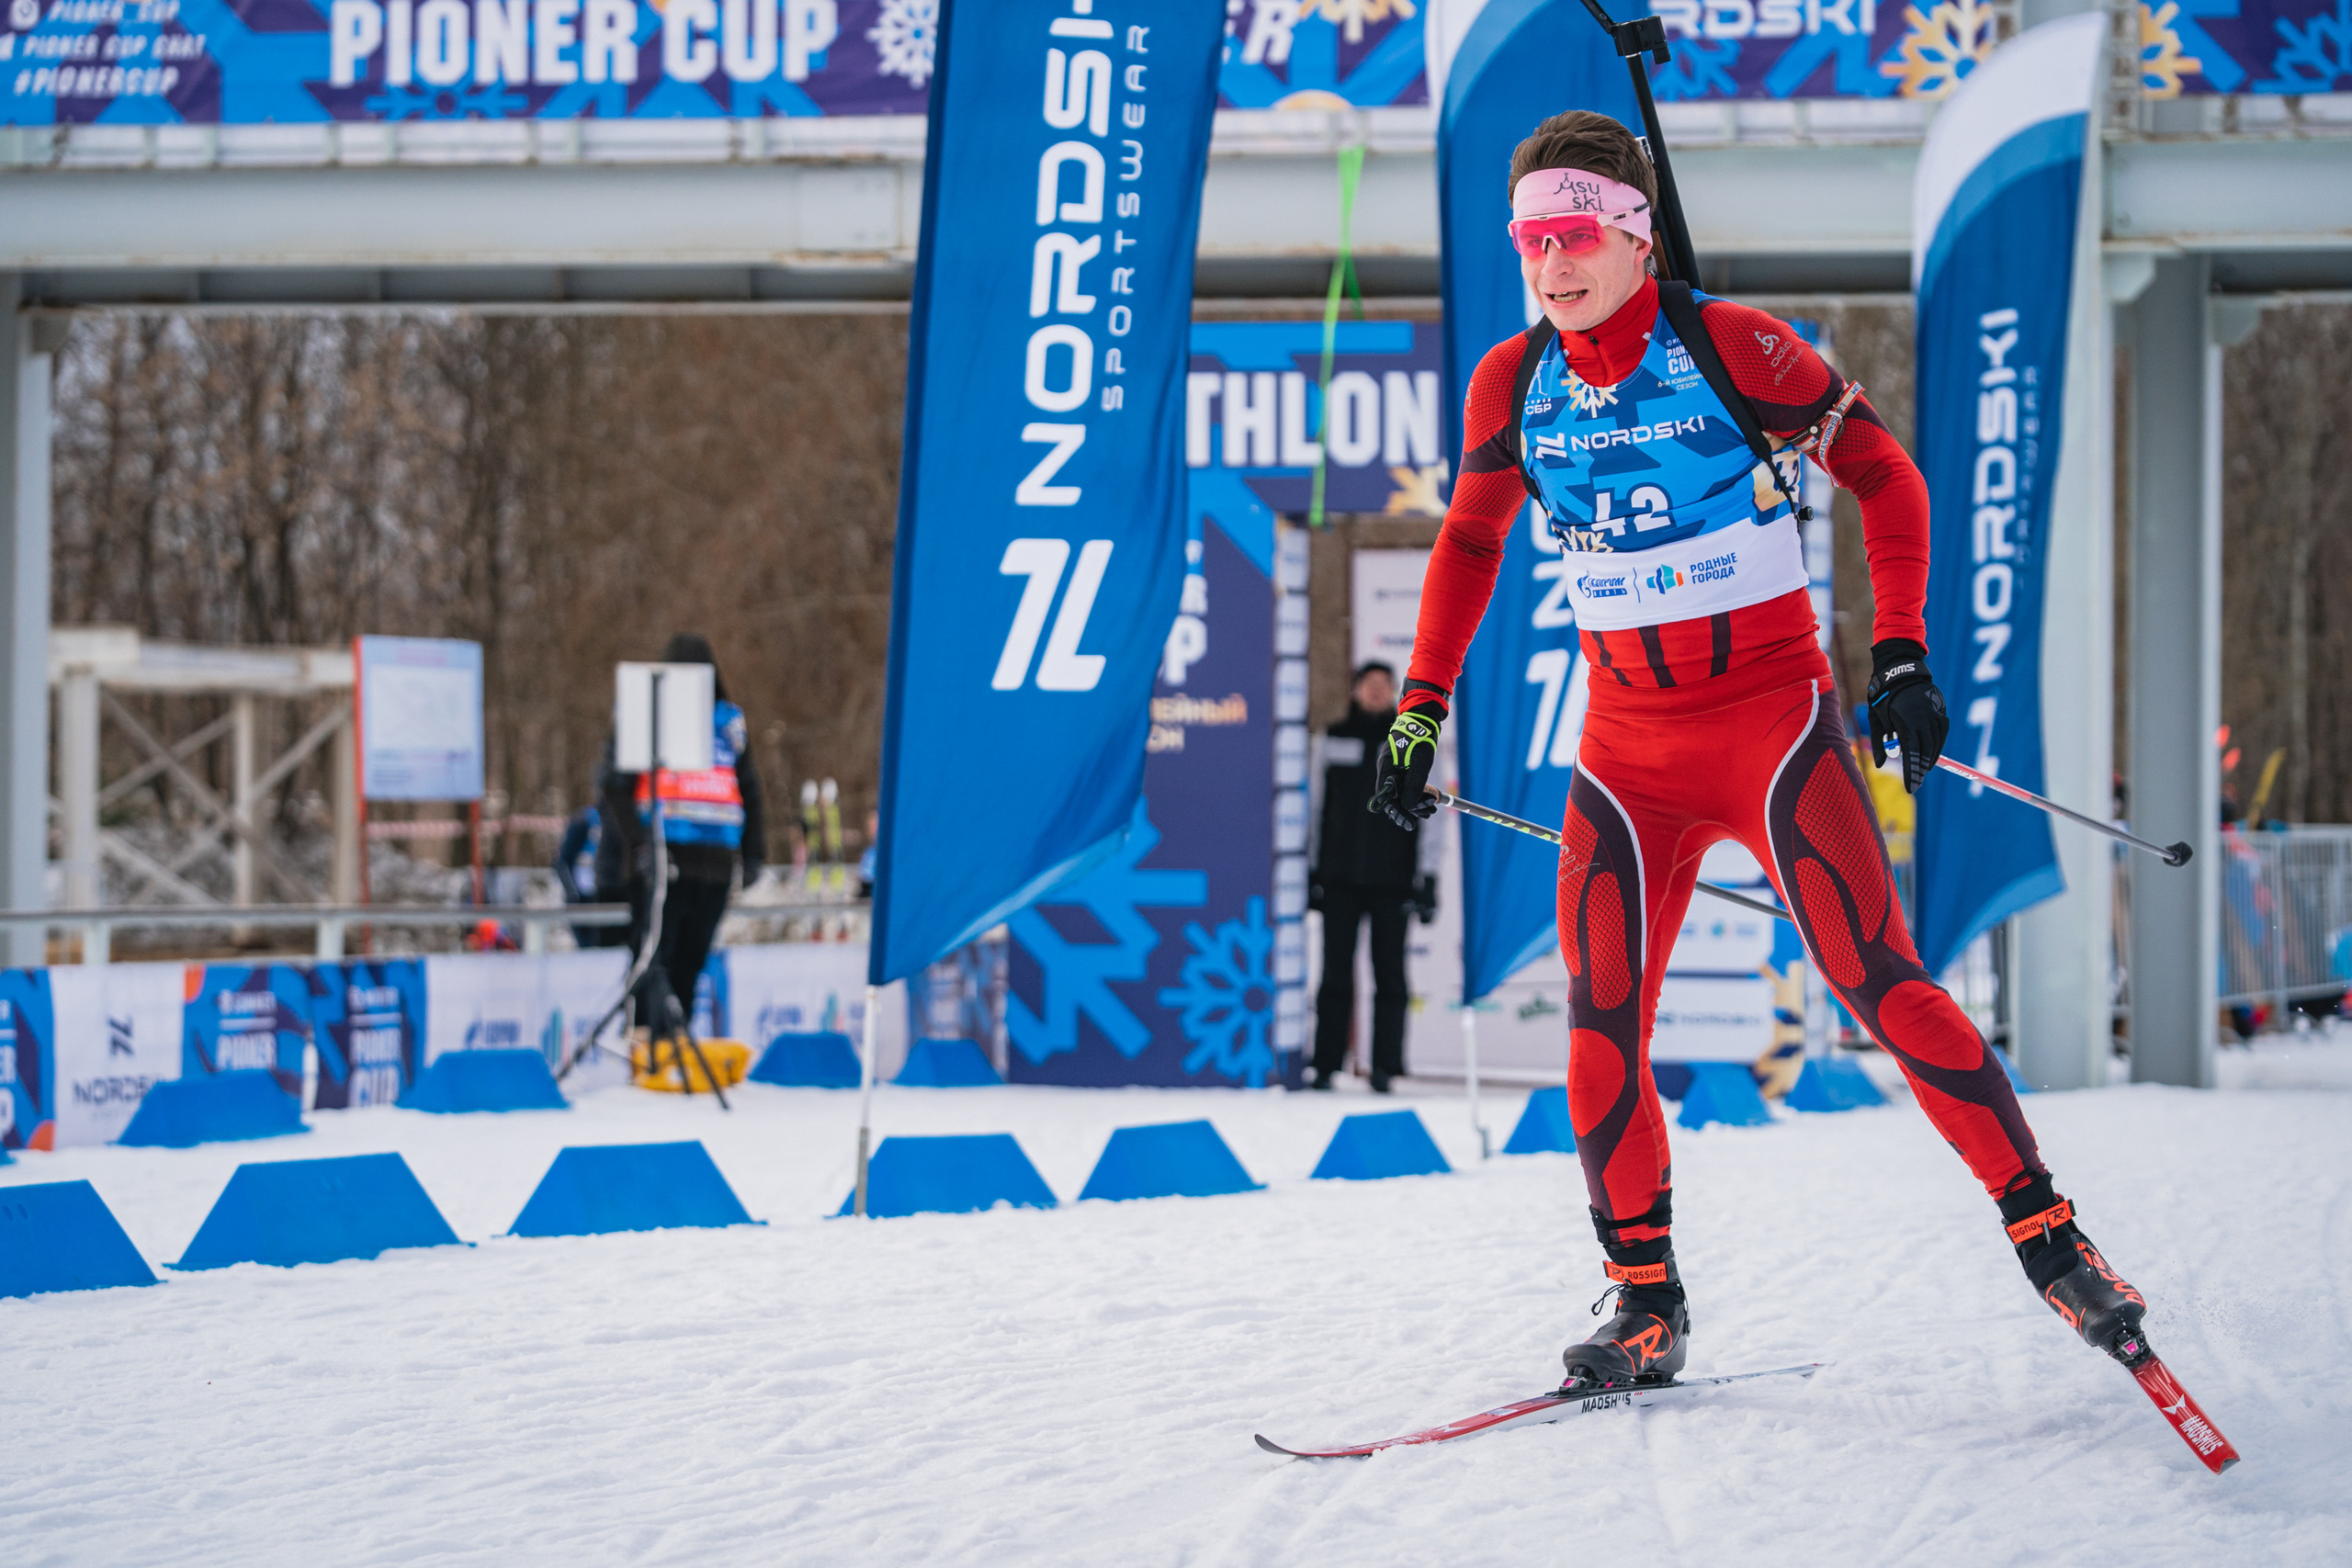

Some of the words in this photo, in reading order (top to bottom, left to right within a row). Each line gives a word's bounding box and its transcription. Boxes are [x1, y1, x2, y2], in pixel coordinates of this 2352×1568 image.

[329, 0, 638, 87] PIONER
[662, 0, 837, 82] CUP
[13, 65, 180, 97] #PIONERCUP
[1101, 24, 1150, 412] SPORTSWEAR
[1671, 372, 1703, 385] ЮБИЛЕЙН
[1676, 381, 1699, 391] СЕЗОН
[1525, 403, 1552, 415] СБР
[1570, 414, 1706, 453] NORDSKI
[1969, 308, 2018, 684] NORDSKI
[1590, 486, 1672, 537] 42
[1690, 551, 1738, 574] РОДНЫЕ
[1691, 565, 1736, 585] ГОРОДА
[1884, 663, 1916, 682] SWIX
[2010, 1220, 2042, 1239] SIGNOL
[2179, 1415, 2224, 1456] MADSHUS
